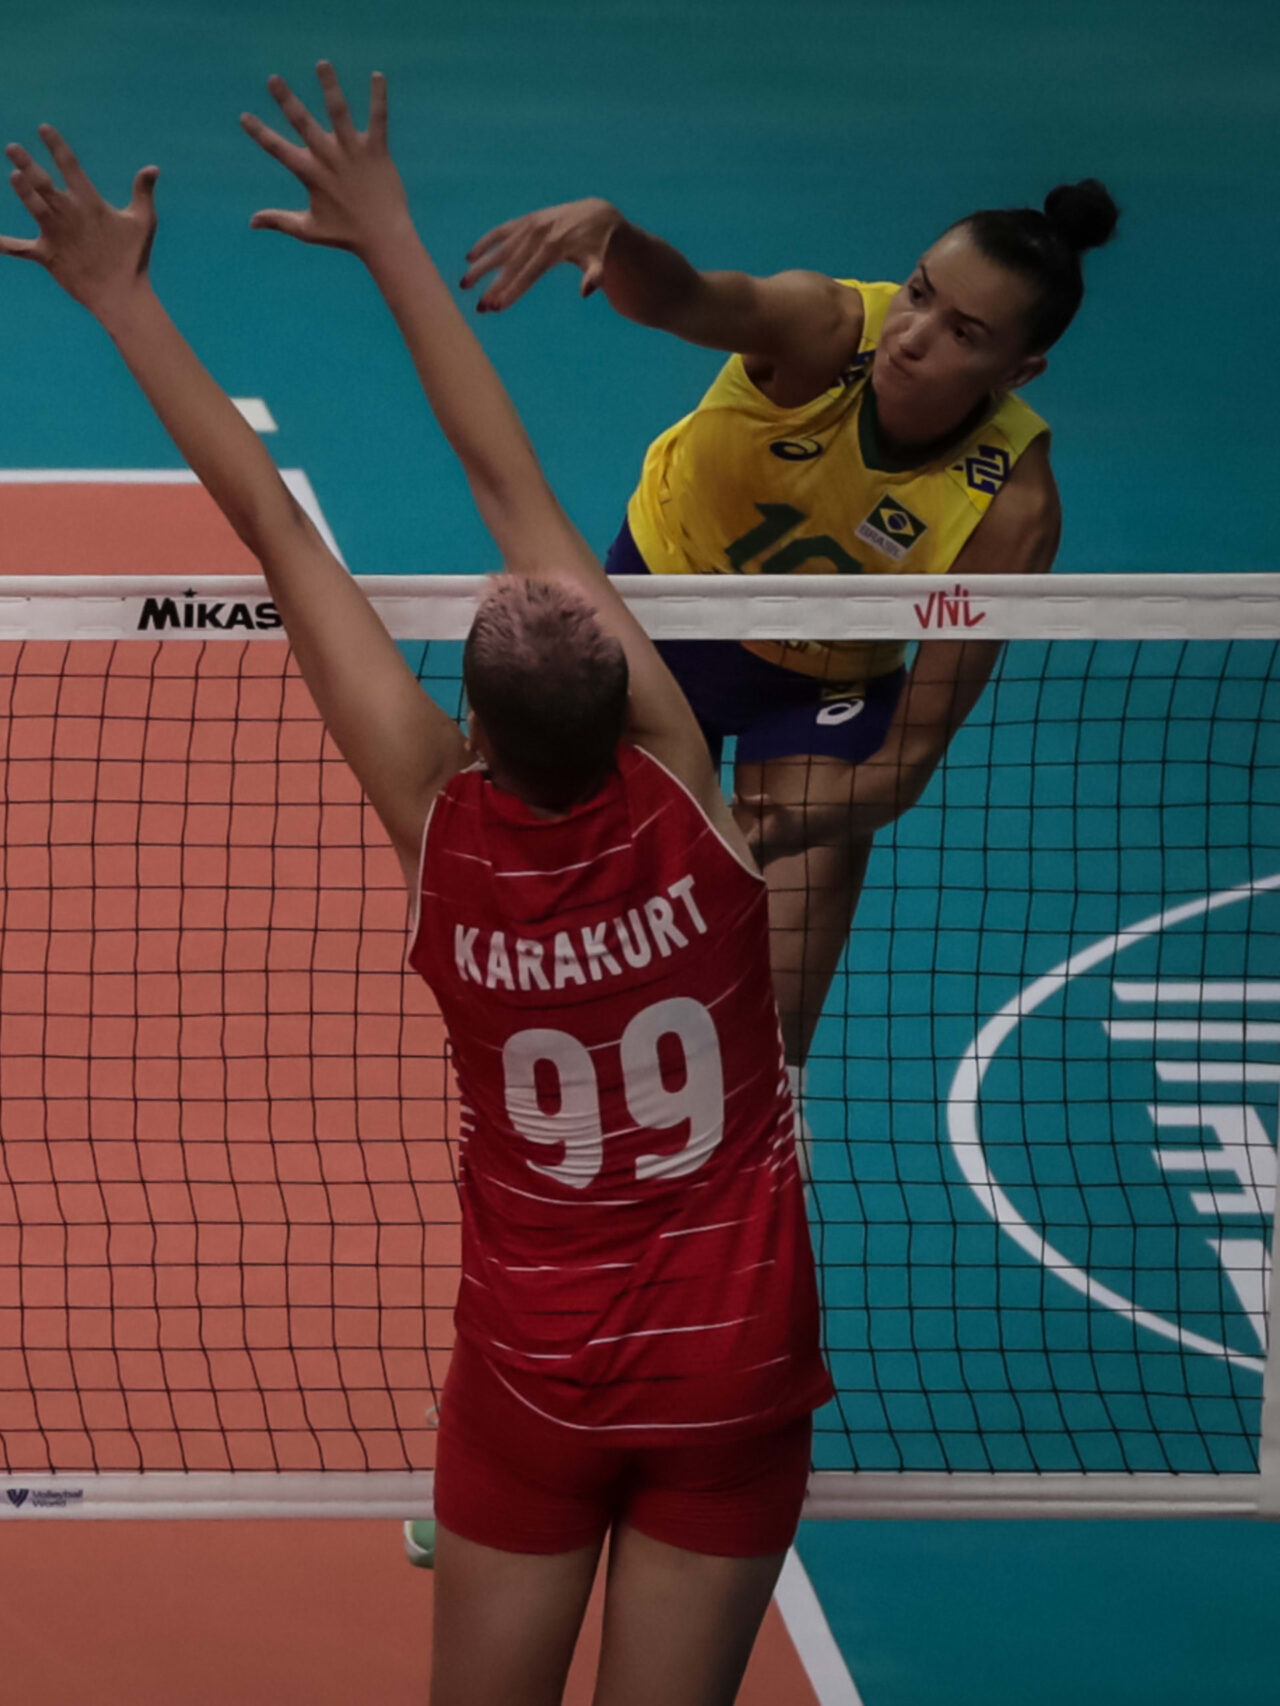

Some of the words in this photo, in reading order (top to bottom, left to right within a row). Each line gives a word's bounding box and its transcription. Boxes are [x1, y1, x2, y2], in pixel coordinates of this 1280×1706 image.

[858, 524, 902, 557] BRASIL
[137, 588, 284, 630] MIKAS
[914, 584, 986, 629] VNL
[455, 874, 708, 991] KARAKURT
[502, 997, 724, 1189] 99
